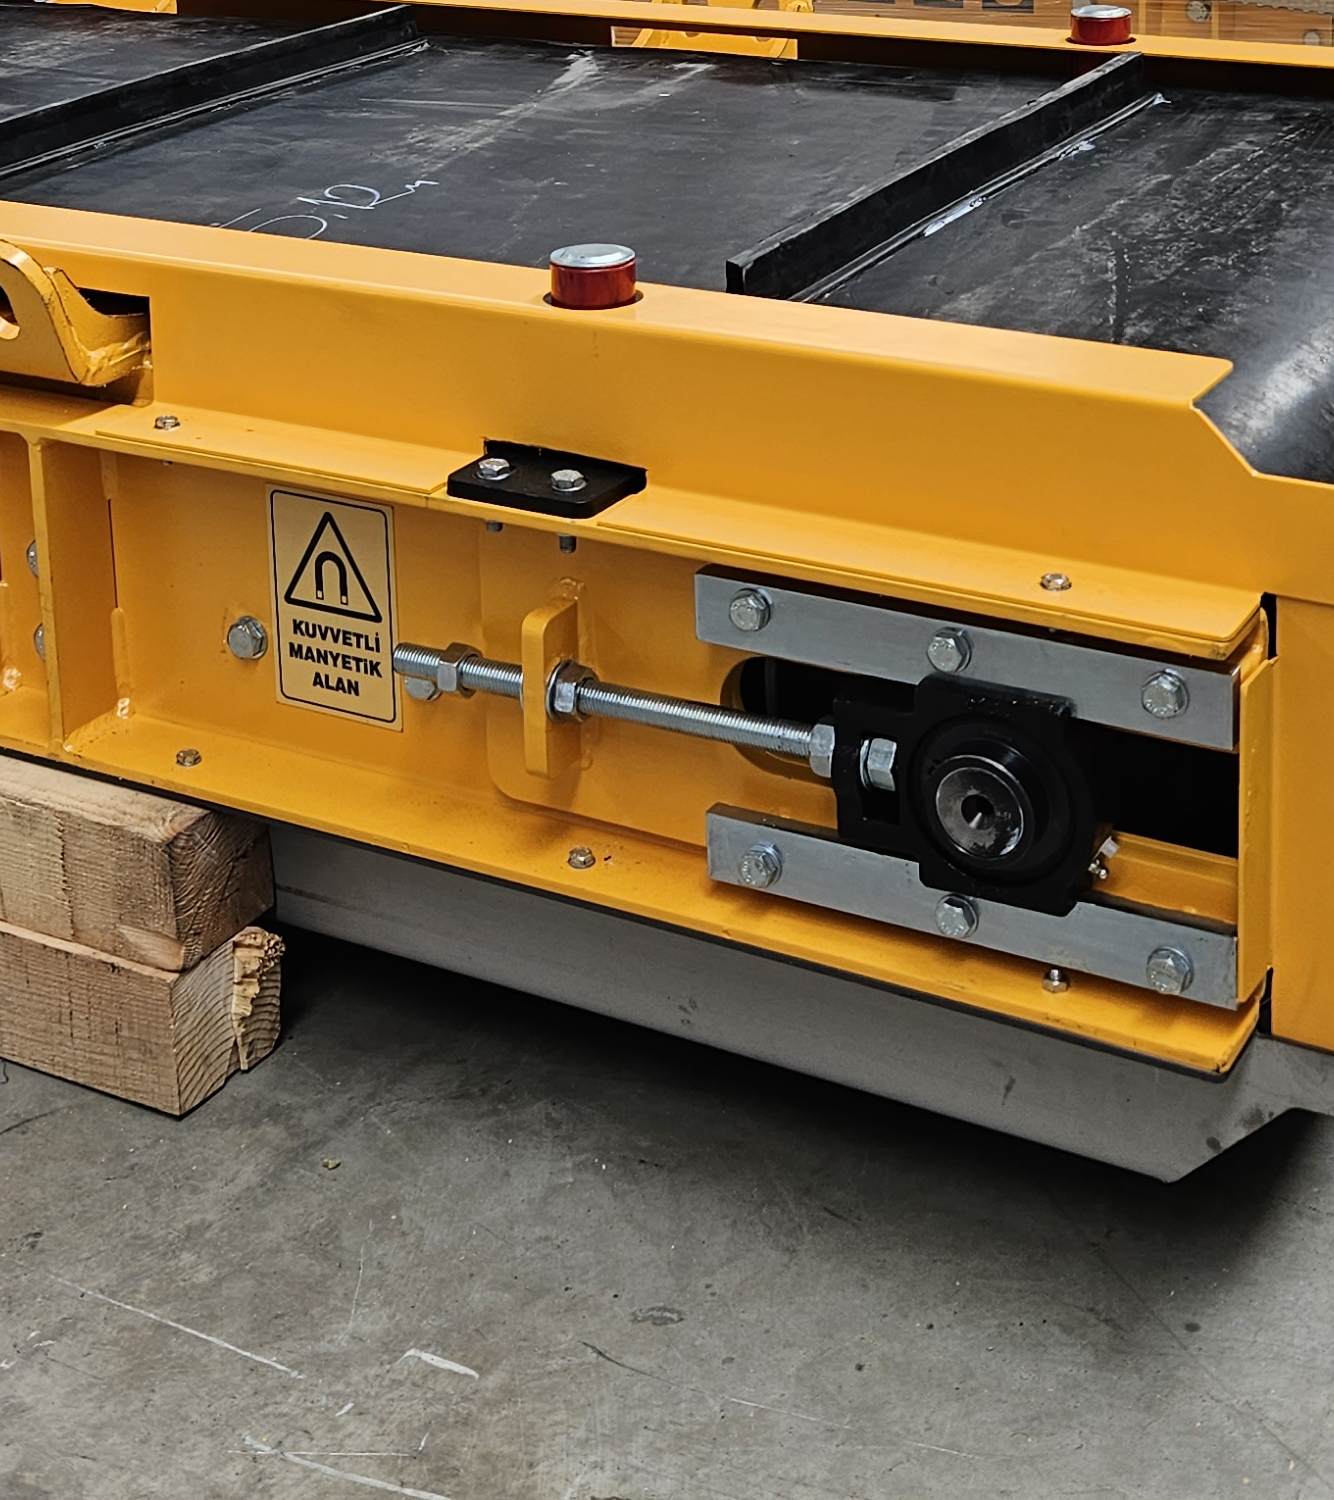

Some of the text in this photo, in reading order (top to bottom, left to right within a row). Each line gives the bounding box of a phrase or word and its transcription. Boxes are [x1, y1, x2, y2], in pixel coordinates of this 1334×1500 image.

[292, 619, 380, 653] KUVVETLİ
[289, 642, 383, 678] MANYETİK
[312, 672, 360, 697] ALAN
